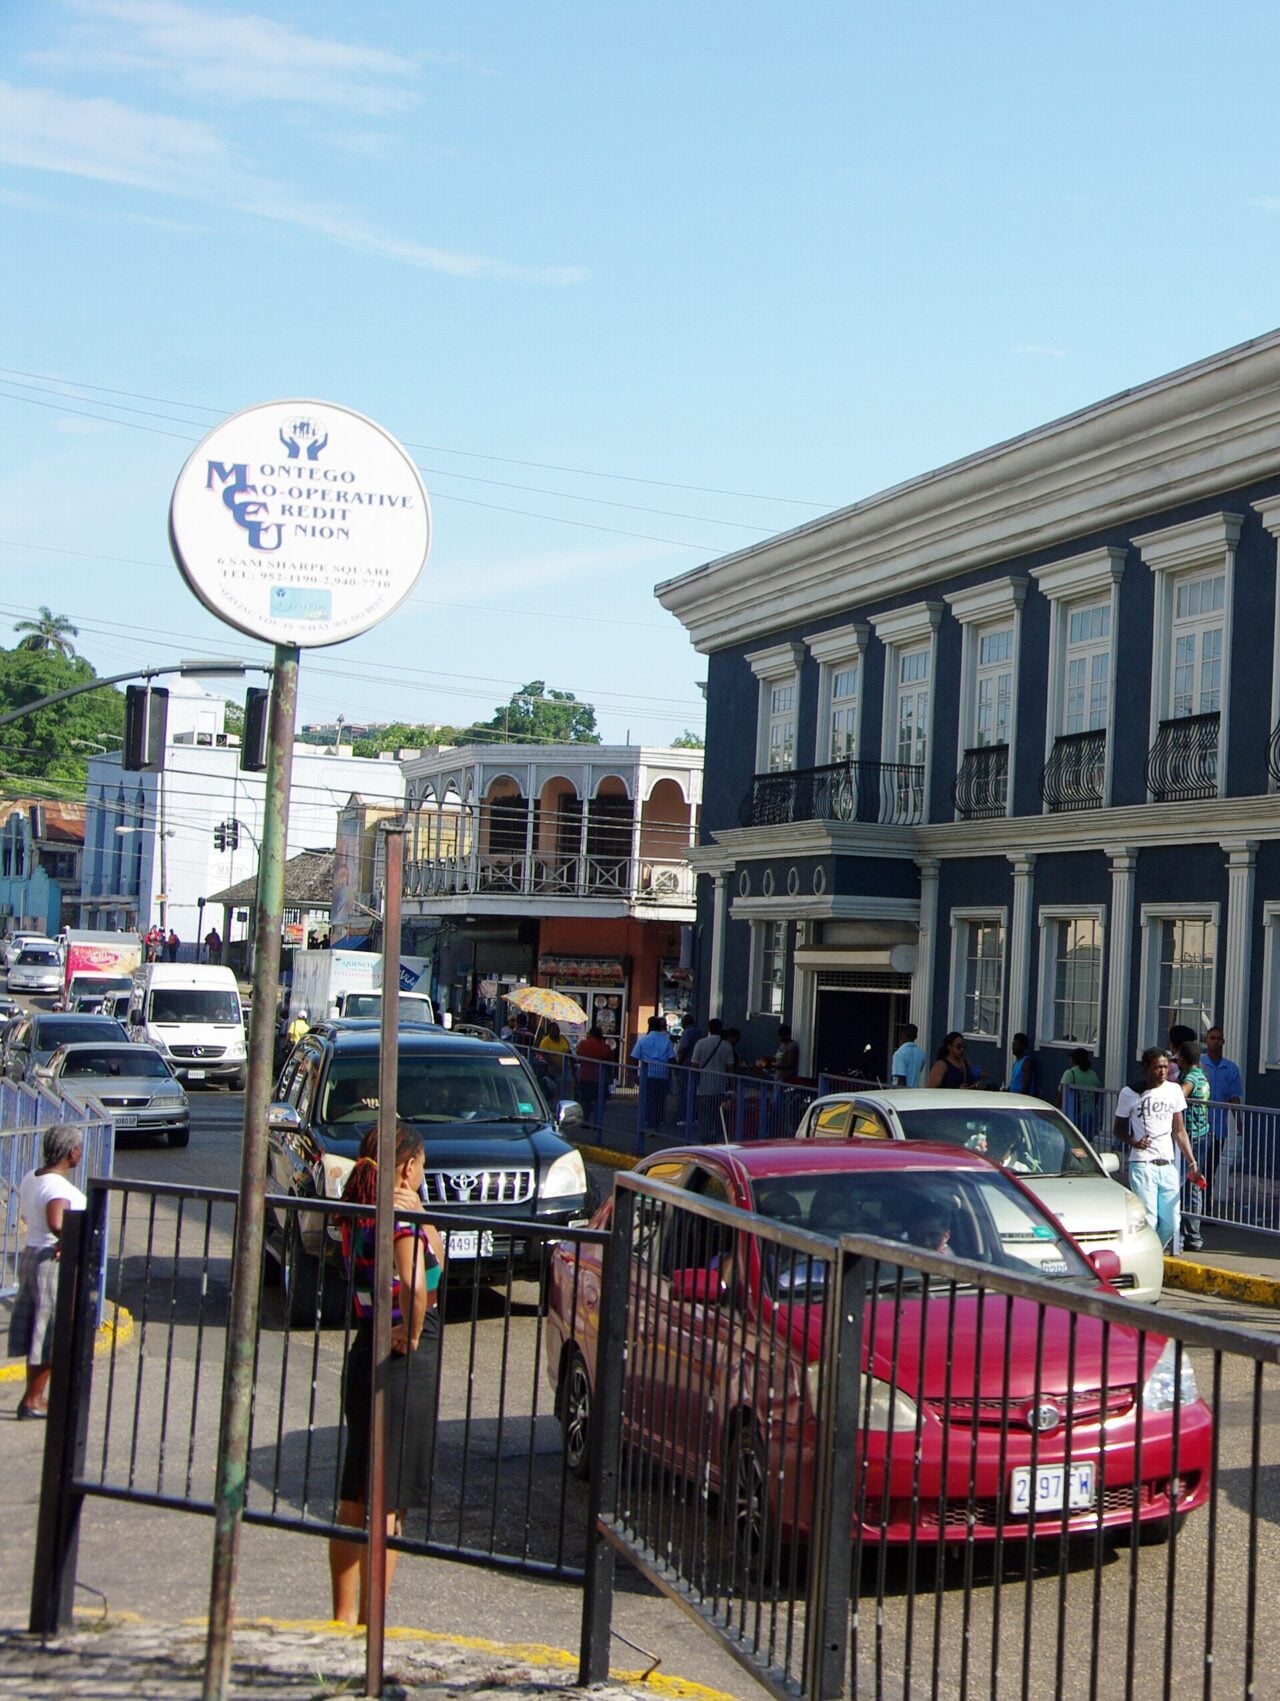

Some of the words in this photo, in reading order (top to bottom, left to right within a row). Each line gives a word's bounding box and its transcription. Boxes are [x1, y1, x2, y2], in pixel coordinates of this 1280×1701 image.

[229, 558, 262, 567] SAM
[267, 560, 328, 572] SHARPE
[333, 565, 392, 577] SQUARE
[1016, 1475, 1061, 1502] 297
